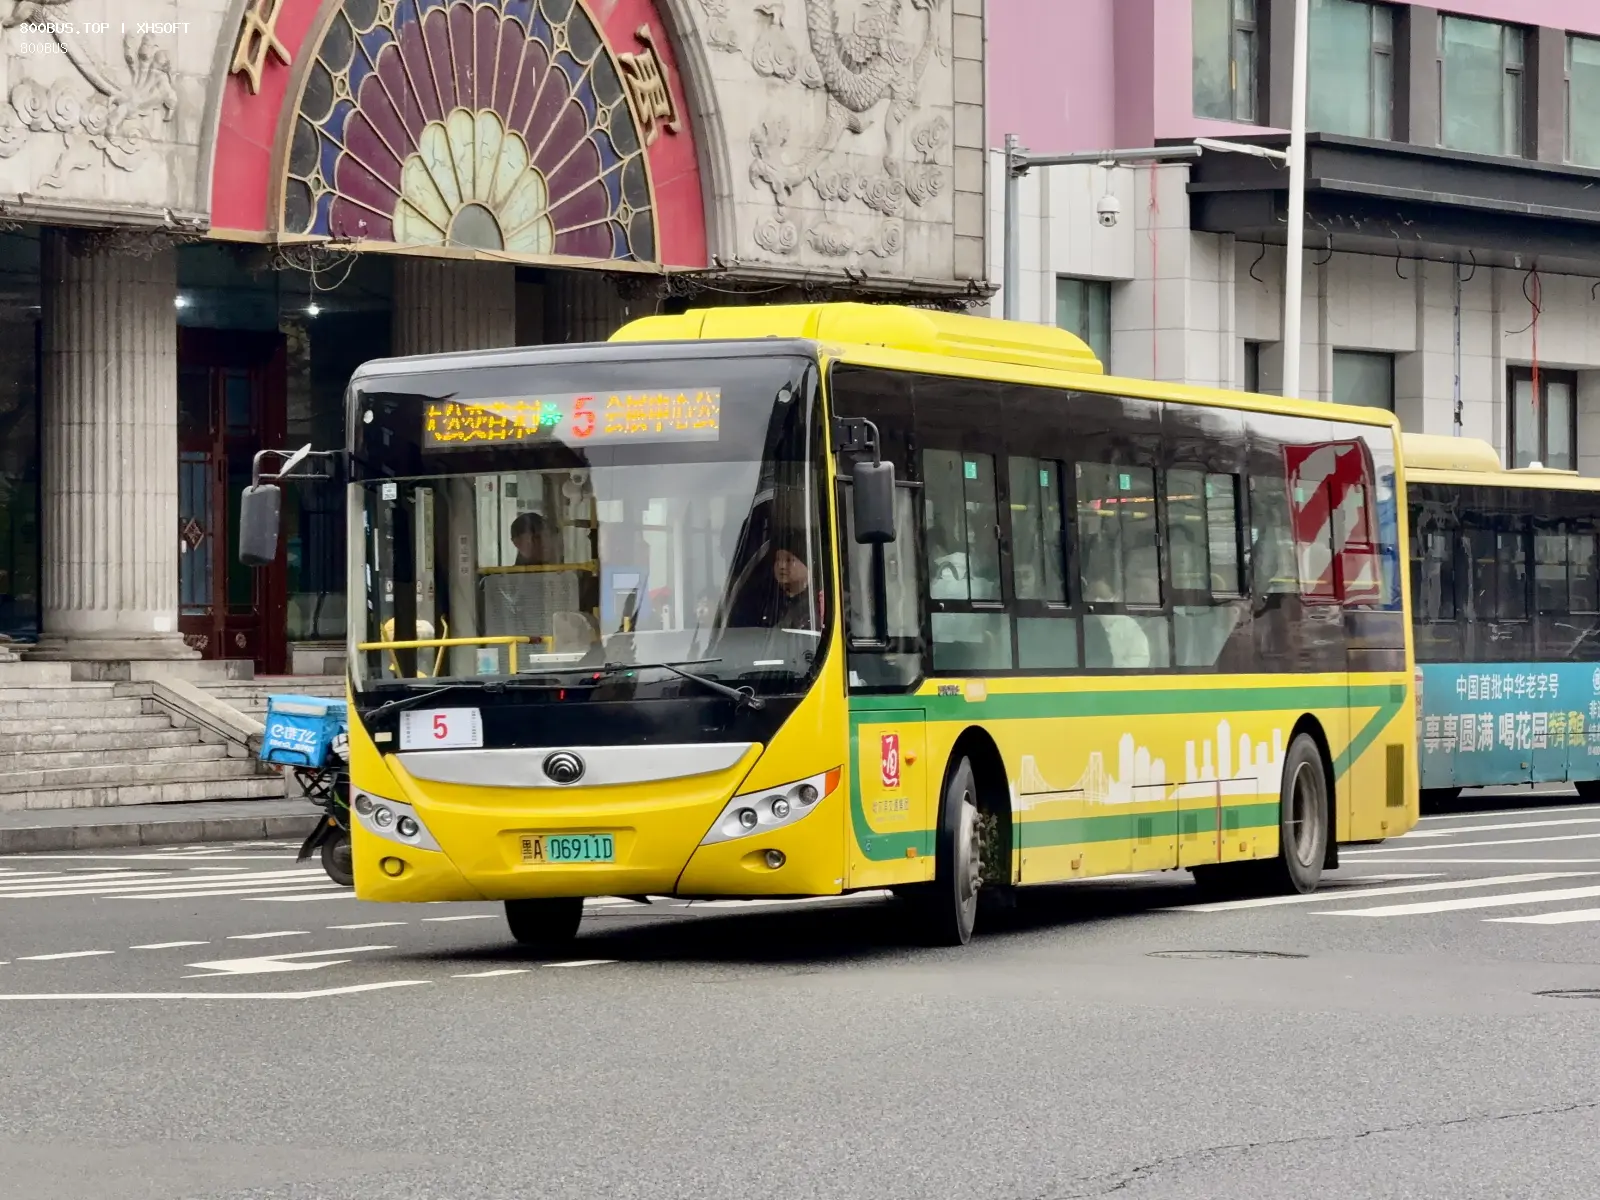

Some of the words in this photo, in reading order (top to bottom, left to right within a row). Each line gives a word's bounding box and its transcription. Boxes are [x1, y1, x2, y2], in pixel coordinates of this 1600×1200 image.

[571, 395, 597, 438] 5
[1456, 673, 1559, 701] 中国首批中华老字号
[433, 714, 449, 740] 5
[1423, 711, 1494, 754] 事事圆满
